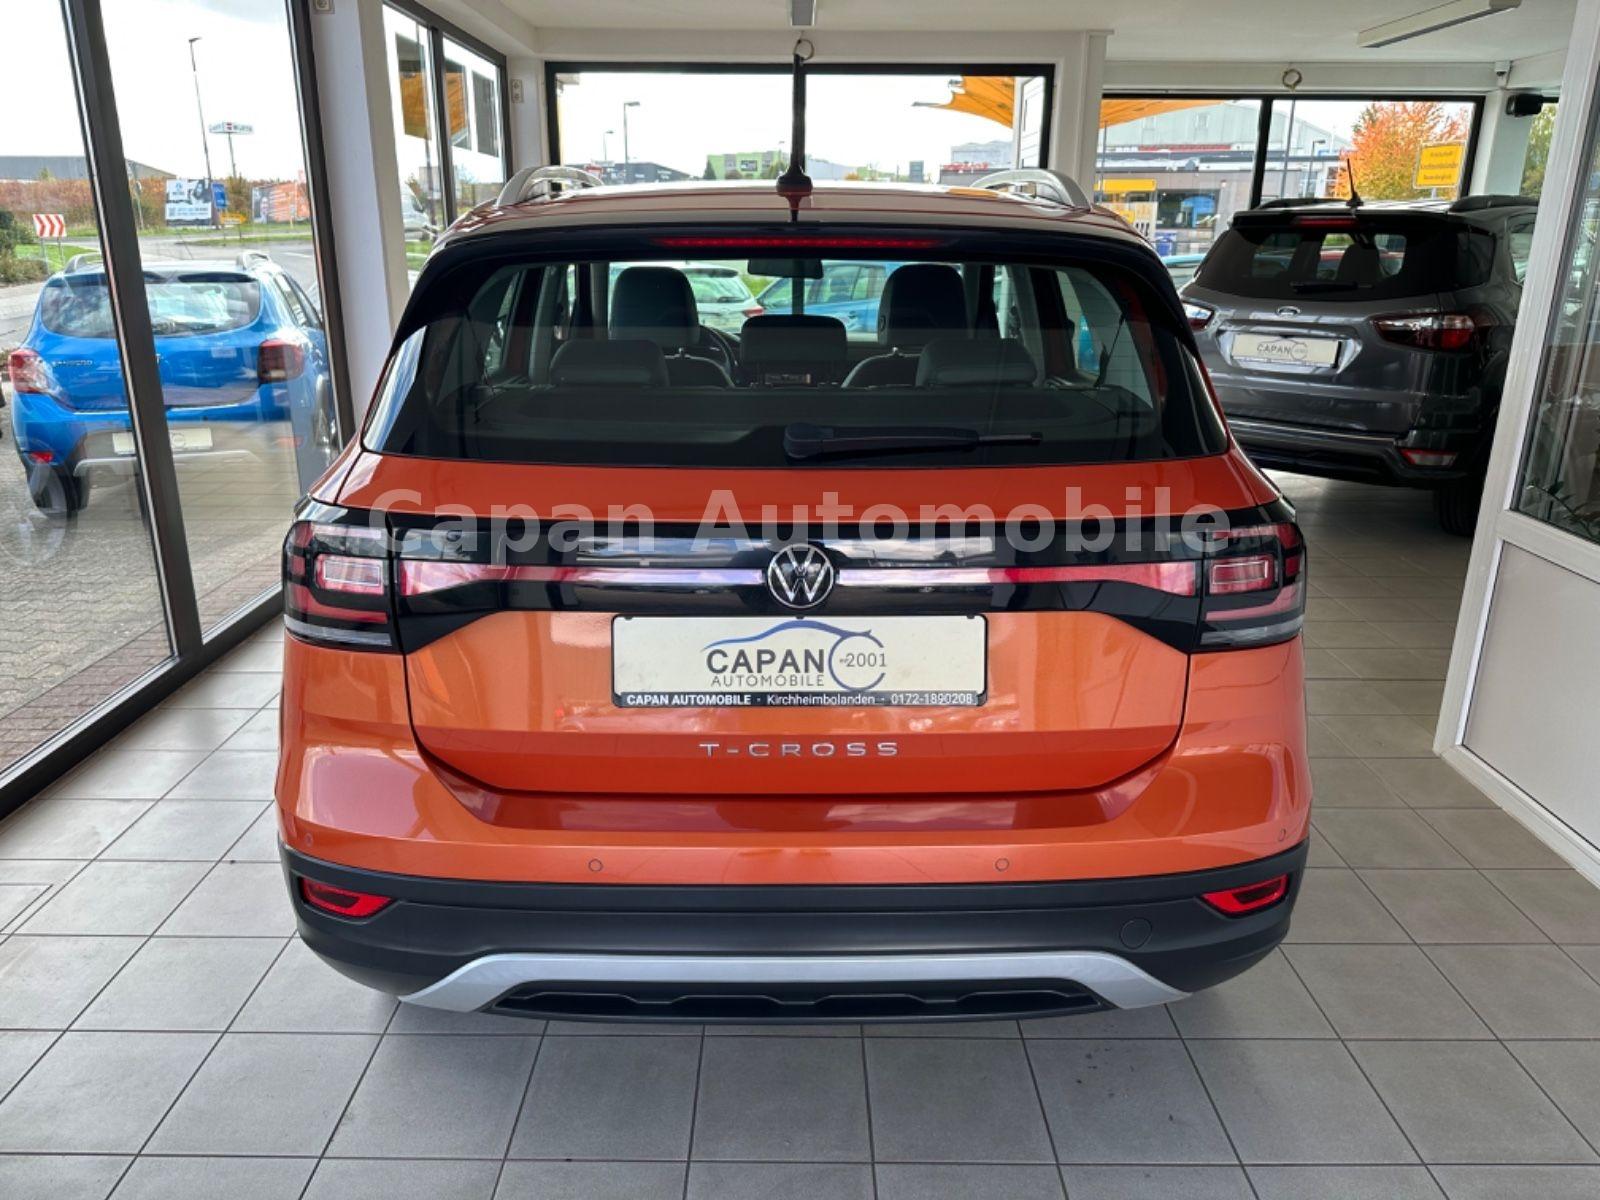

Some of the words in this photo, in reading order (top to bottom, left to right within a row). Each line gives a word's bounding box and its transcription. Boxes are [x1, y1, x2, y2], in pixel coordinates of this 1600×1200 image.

[706, 649, 825, 674] CAPAN
[846, 652, 887, 667] 2001
[710, 674, 825, 688] AUTOMOBILE
[626, 694, 669, 706] CAPAN
[671, 694, 752, 706] AUTOMOBILE
[766, 693, 876, 706] Kirchheimbolanden
[698, 742, 900, 757] T-CROSS
